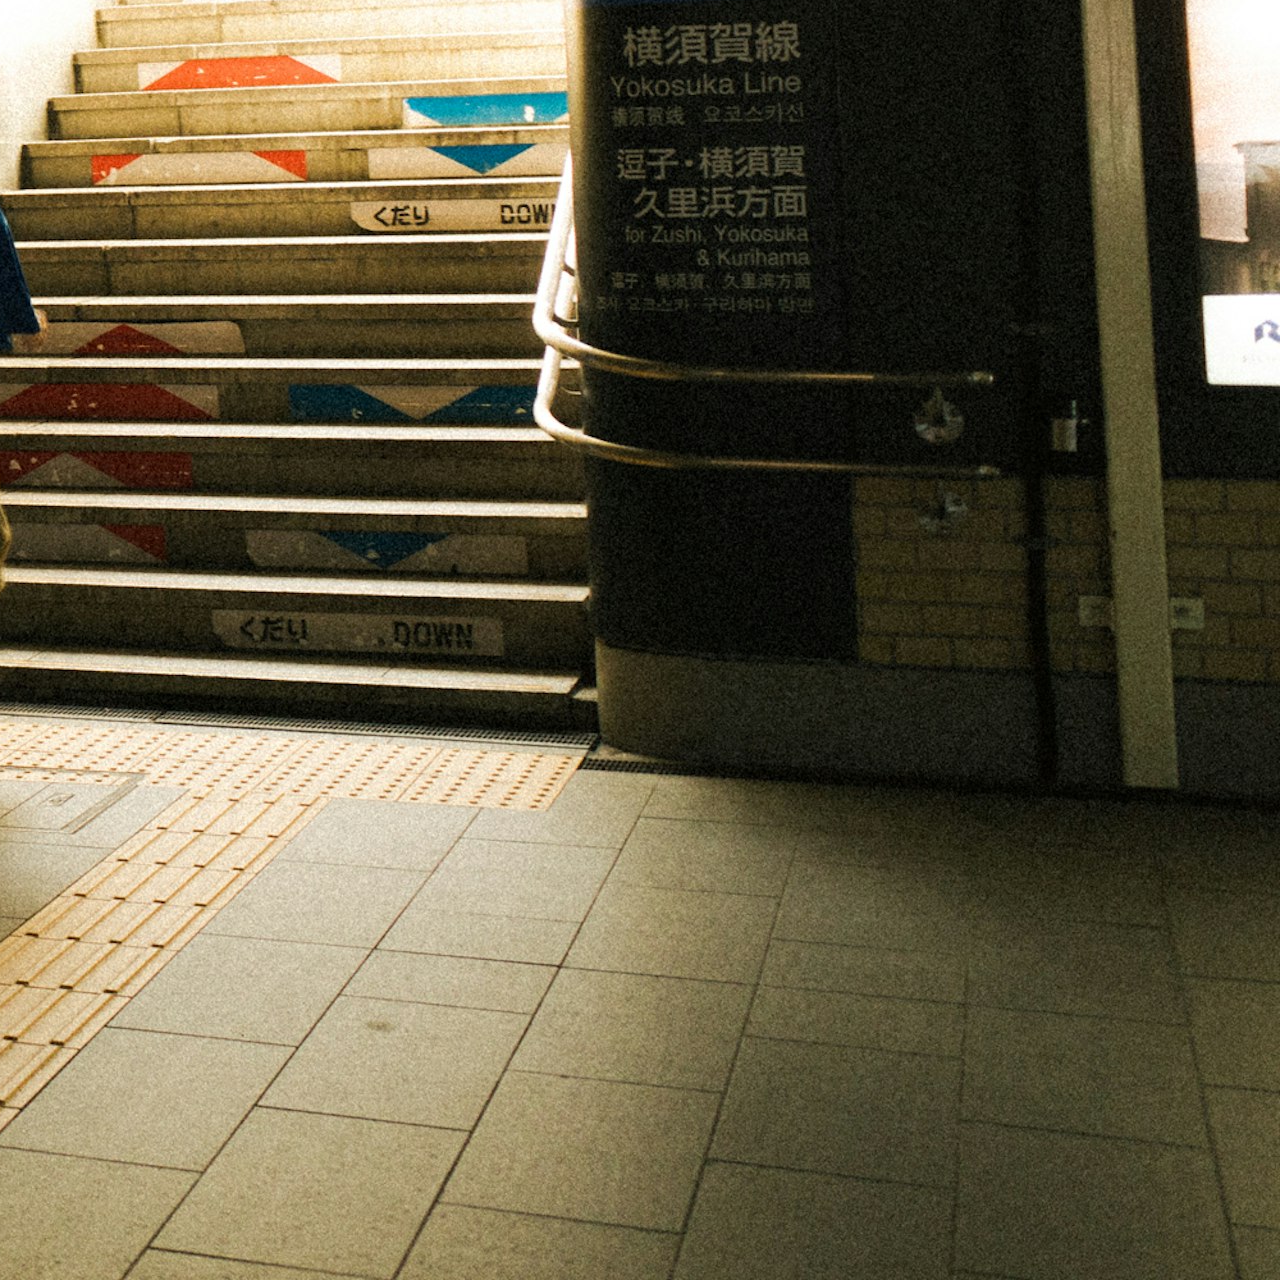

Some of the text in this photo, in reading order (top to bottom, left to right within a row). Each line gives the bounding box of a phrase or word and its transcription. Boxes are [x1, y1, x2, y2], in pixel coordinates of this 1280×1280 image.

[623, 19, 801, 68] 横須賀線
[610, 71, 802, 99] Yokosuka Line
[616, 144, 807, 181] 逗子・横須賀
[373, 204, 431, 227] くだり
[632, 184, 809, 220] 久里浜方面
[625, 227, 646, 244] for
[714, 223, 809, 243] Yokosuka
[696, 247, 810, 267] & Kurihama
[240, 616, 473, 649] くだり DOWN
